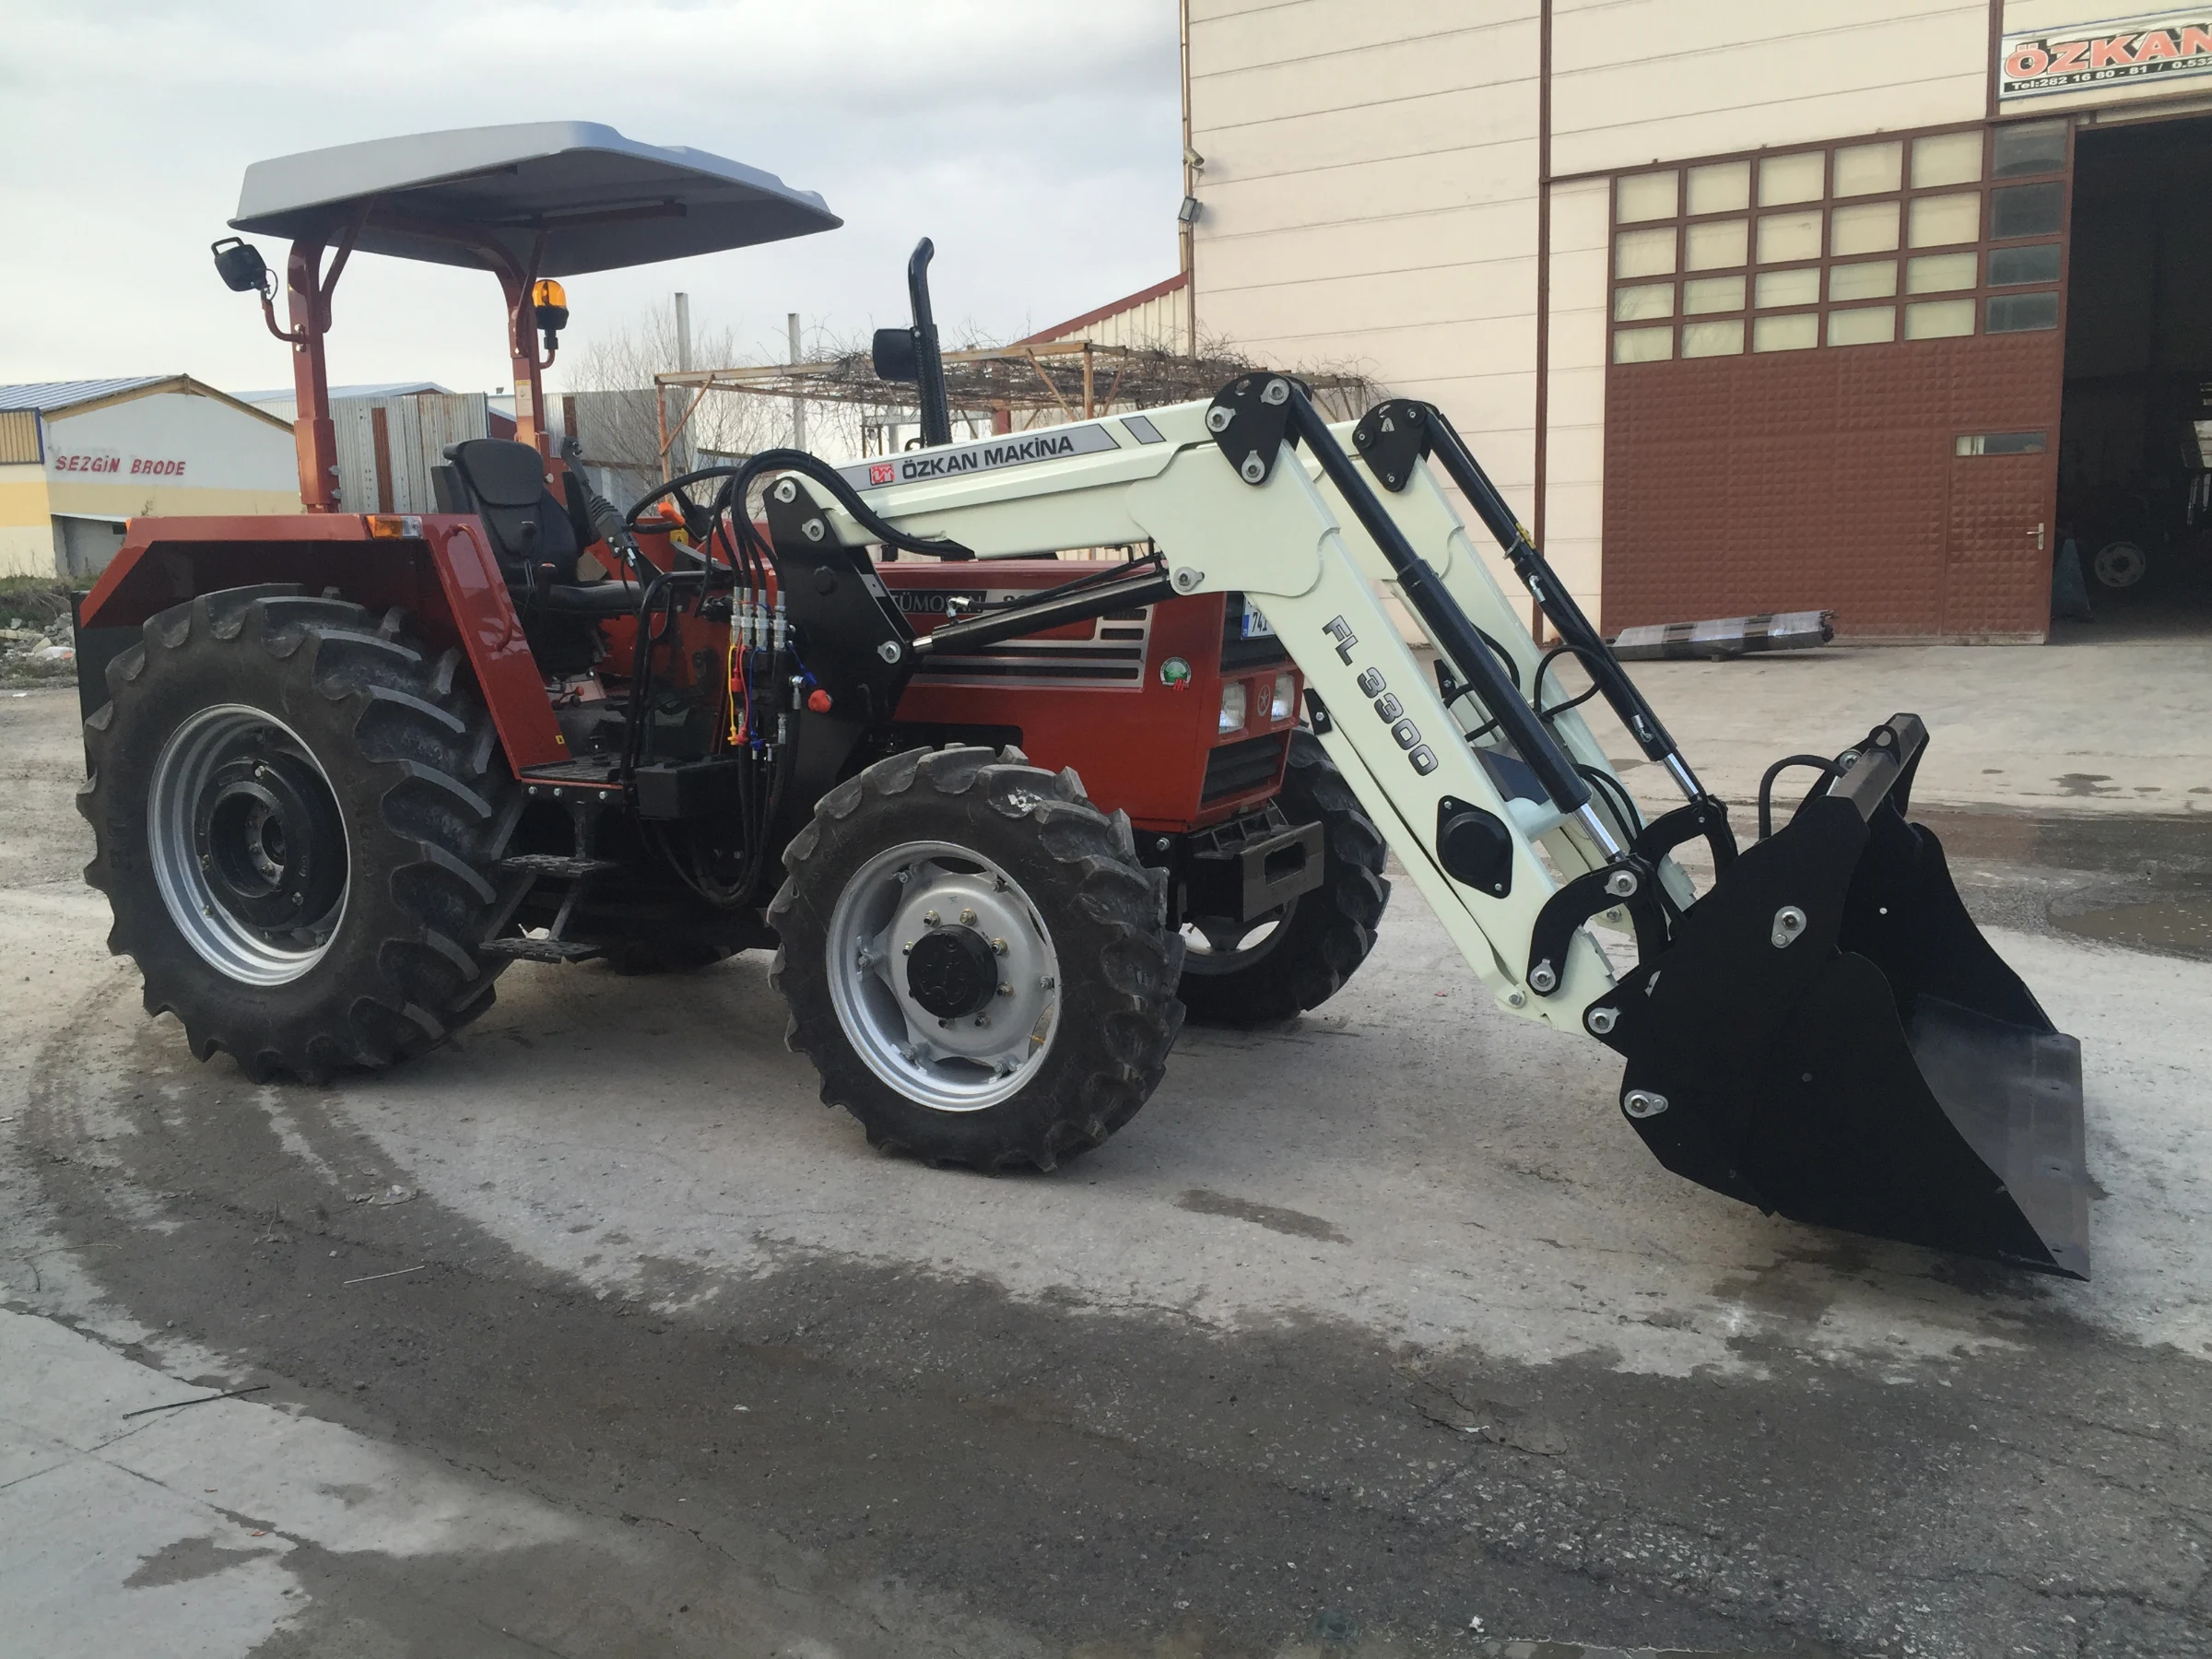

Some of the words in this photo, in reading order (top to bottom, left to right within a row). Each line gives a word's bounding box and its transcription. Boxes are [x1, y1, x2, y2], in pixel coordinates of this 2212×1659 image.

[2005, 26, 2212, 78] ÖZKAN
[2012, 76, 2067, 89] Tel:282
[2073, 73, 2091, 82] 16
[2096, 70, 2115, 79] 80
[2130, 65, 2147, 74] 81
[130, 458, 185, 476] BRODE
[902, 453, 977, 479] ÖZKAN
[985, 436, 1073, 466] MAKİNA
[1322, 615, 1359, 666] FL
[1357, 666, 1439, 776] 3300
